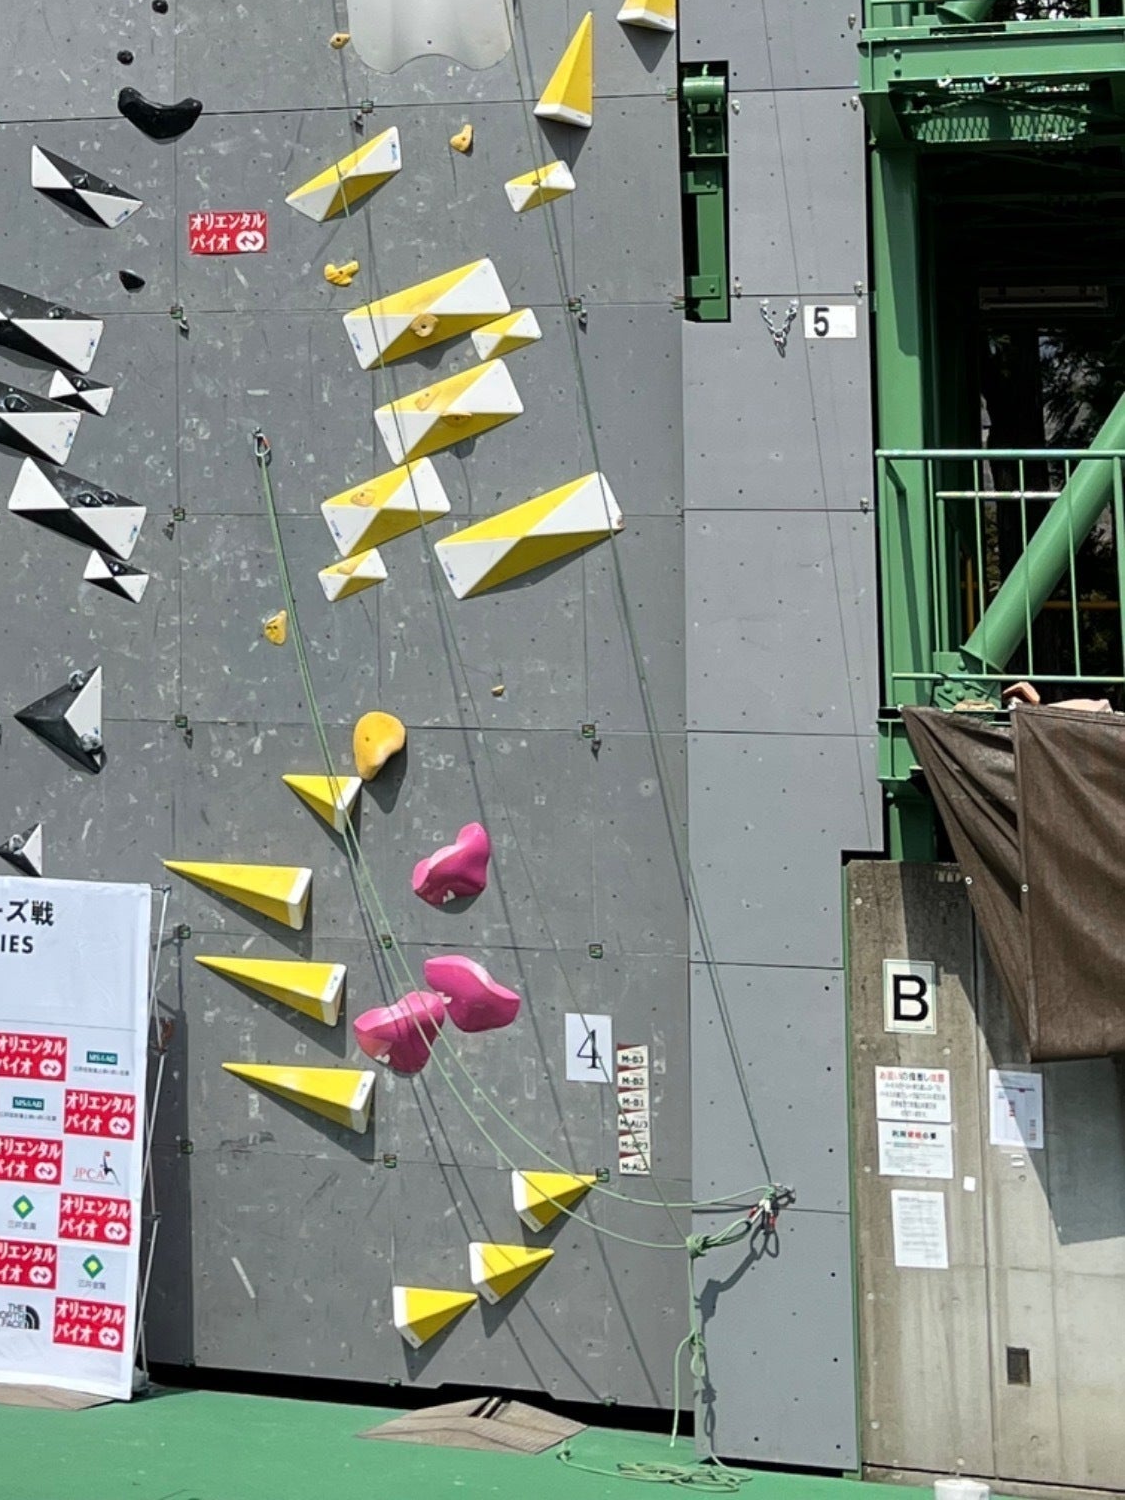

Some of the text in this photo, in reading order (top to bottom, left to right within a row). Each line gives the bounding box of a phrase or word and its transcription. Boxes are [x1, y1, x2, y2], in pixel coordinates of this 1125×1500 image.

[191, 212, 265, 231] オリエンタル
[191, 233, 230, 252] バイオ
[814, 307, 829, 336] 5
[893, 975, 929, 1021] B
[577, 1029, 601, 1069] 4
[65, 1092, 134, 1114] オリエンタル
[64, 1113, 103, 1133] バイオ
[74, 1167, 106, 1180] JPCA
[59, 1196, 130, 1219] オリエンタル
[58, 1217, 98, 1238] バイオ
[55, 1299, 125, 1325] オリエンタル
[53, 1322, 93, 1343] バイオ
